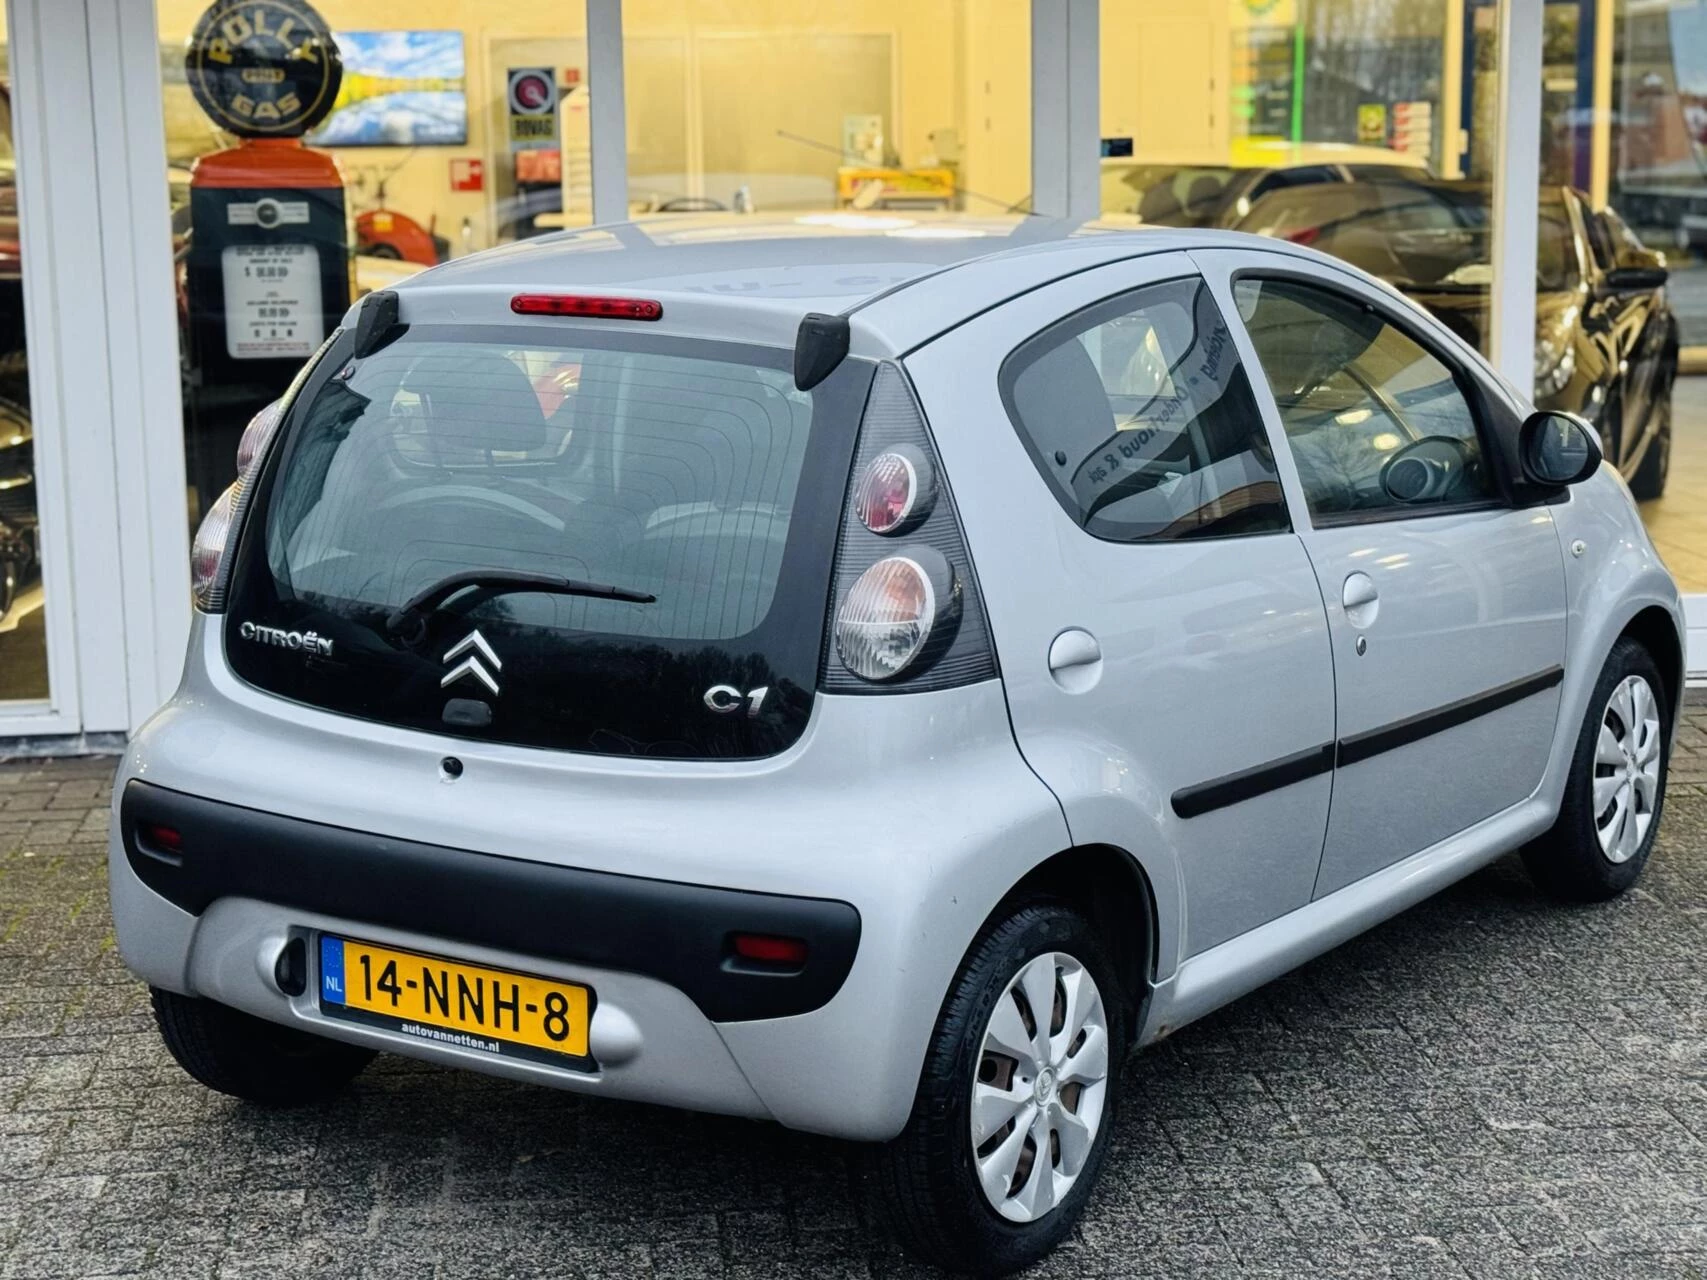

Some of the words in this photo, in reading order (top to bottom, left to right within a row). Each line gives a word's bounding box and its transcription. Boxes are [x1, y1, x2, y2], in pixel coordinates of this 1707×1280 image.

[208, 9, 319, 65] POLLY
[231, 92, 302, 120] GAS
[240, 620, 334, 656] CITROËN
[703, 684, 769, 718] C1
[325, 975, 342, 992] NL
[359, 954, 570, 1042] 14-NNH-8
[401, 1021, 500, 1053] autovannetten.nl
